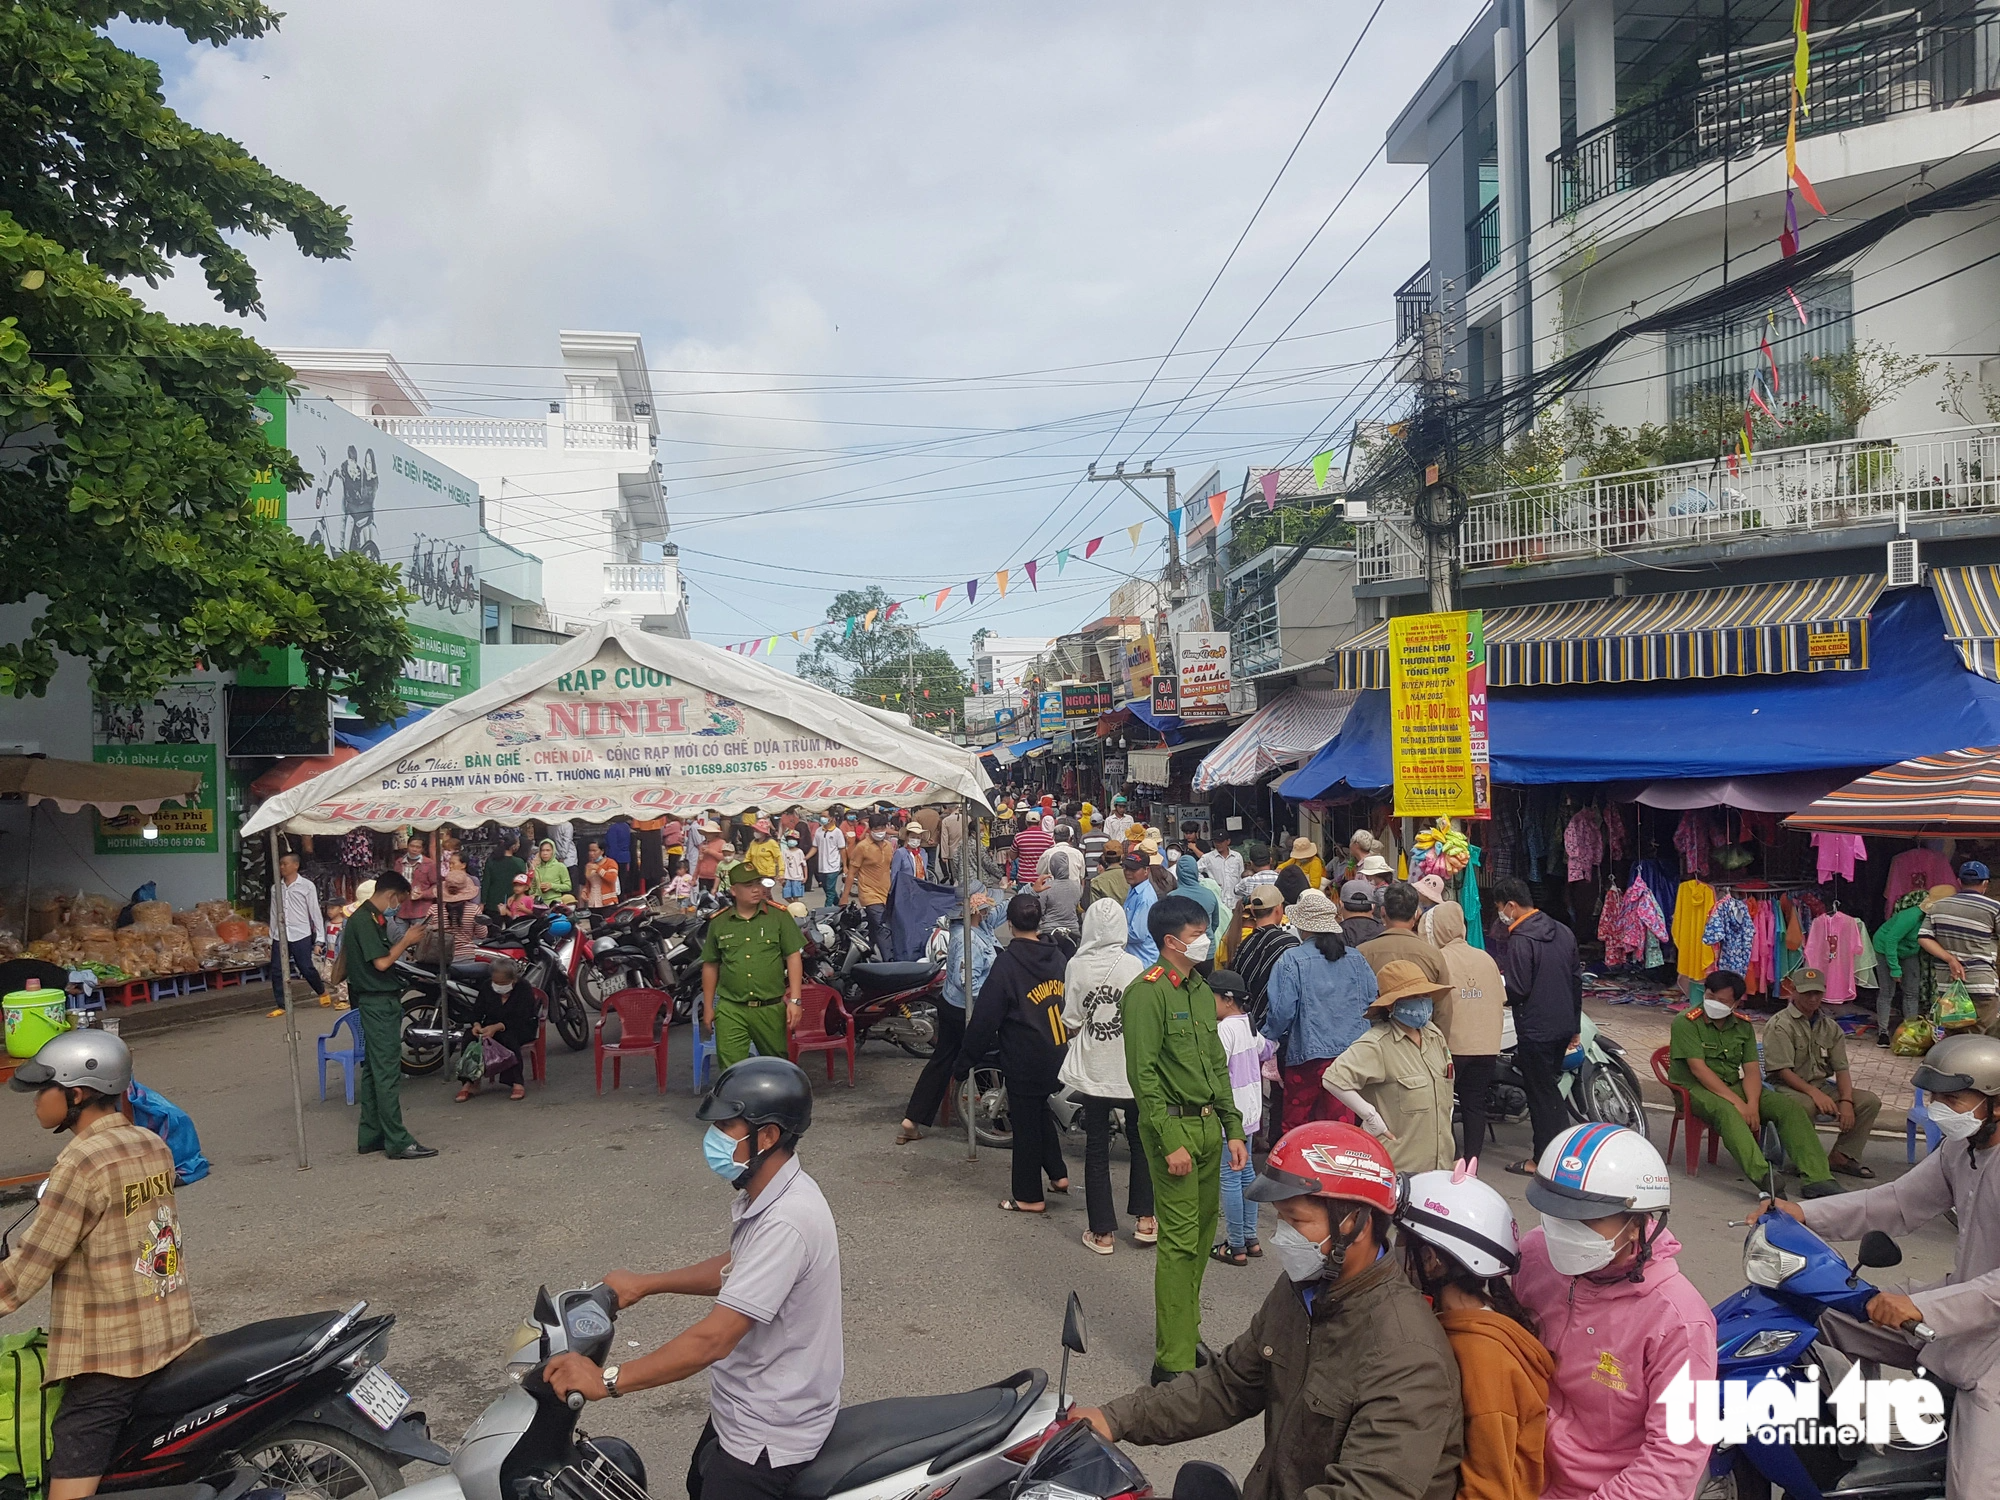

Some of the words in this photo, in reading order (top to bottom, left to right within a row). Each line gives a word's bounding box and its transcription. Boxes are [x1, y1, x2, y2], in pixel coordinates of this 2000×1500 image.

[392, 454, 402, 475] XE
[404, 460, 421, 485] ĐIỆN
[422, 469, 442, 494] PEGA
[441, 643, 450, 655] AN
[450, 644, 466, 658] GIANG
[1403, 645, 1430, 654] PHIÊN
[1433, 643, 1451, 652] CHỢ
[1828, 641, 1848, 650] CHIẾN
[1400, 656, 1435, 665] THƯƠNG
[1437, 655, 1455, 665] MẠI
[450, 664, 461, 687] 2
[1182, 664, 1195, 675] GÀ
[1197, 662, 1216, 673] RÁN
[1406, 666, 1429, 676] TỔNG
[1432, 666, 1450, 675] HỢP
[1194, 673, 1207, 683] GÀ
[1209, 669, 1226, 681] LẮC
[1158, 679, 1172, 694] GÀ
[1183, 685, 1201, 695] Khoai
[1202, 685, 1216, 694] Lang
[1065, 694, 1091, 708] NGỌC
[1094, 693, 1110, 705] NHI
[1410, 692, 1426, 701] NĂM
[1155, 697, 1175, 711] RÁN
[546, 697, 689, 740] NINH
[107, 753, 128, 765] ĐỔI
[131, 754, 159, 765] BÌNH
[162, 751, 179, 765] ẮC
[183, 754, 209, 765] QUY
[397, 760, 421, 774] Cho
[426, 757, 458, 771] Thuê:
[464, 751, 495, 768] BÀN
[496, 748, 522, 767] GHẾ
[533, 749, 570, 766] CHÉN
[572, 747, 593, 763] DĨA
[606, 744, 640, 762] CỔNG
[644, 745, 669, 762] RẠP
[675, 738, 699, 758] MỚI
[702, 739, 721, 757] CÓ
[723, 737, 750, 756] GHẾ
[754, 738, 780, 755] DỰA
[784, 735, 820, 753] TRÙM
[382, 780, 401, 791] ĐC:
[403, 773, 418, 789] SỐ
[421, 778, 428, 789] 4
[431, 776, 465, 789] PHẠM
[467, 773, 491, 786] VĂN
[494, 771, 525, 784] ĐỒNG
[535, 771, 554, 782] TT.
[556, 767, 601, 781] THƯƠNG
[604, 766, 625, 780] MẠI
[629, 763, 651, 778] PHÚ
[654, 763, 672, 777] MỸ
[686, 760, 768, 776] 01689.803765
[778, 756, 859, 771] 01998.470486
[1424, 785, 1438, 796] cổng
[318, 798, 461, 822] Kính
[472, 794, 617, 815] Chào
[630, 785, 733, 811] Quí
[741, 775, 937, 800] Khách
[175, 821, 208, 833] Hàng
[107, 838, 147, 848] HOTLINE:
[149, 837, 169, 848] 0939
[170, 837, 181, 847] 06
[183, 837, 194, 847] 09
[195, 837, 206, 847] 06
[1461, 988, 1482, 999] CoCo
[1345, 1149, 1372, 1160] motor
[152, 1403, 229, 1448] SIRIUS
